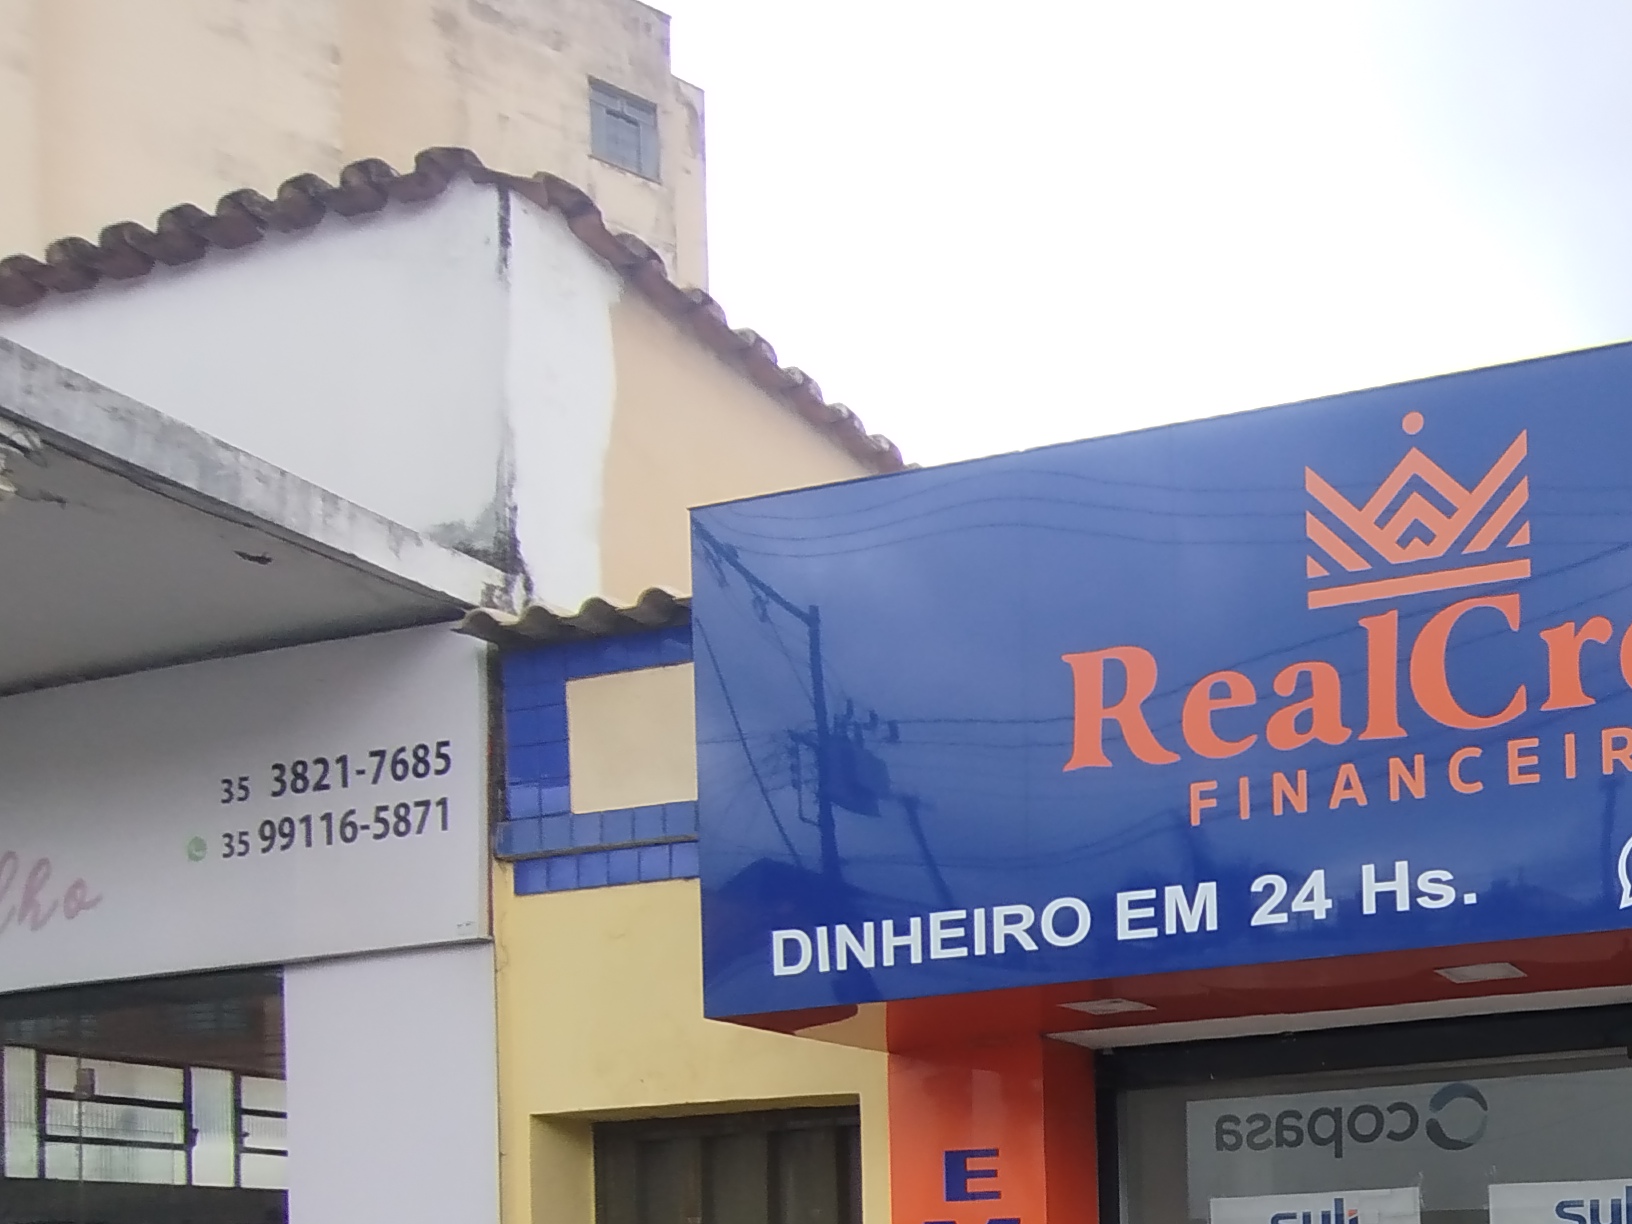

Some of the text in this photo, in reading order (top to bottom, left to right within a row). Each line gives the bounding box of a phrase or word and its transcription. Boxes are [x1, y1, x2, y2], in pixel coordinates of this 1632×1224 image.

[220, 740, 453, 804] 35 3821-7685
[221, 797, 451, 859] 35 99116-5871
[771, 859, 1478, 977] DINHEIRO EM 24 Hs.
